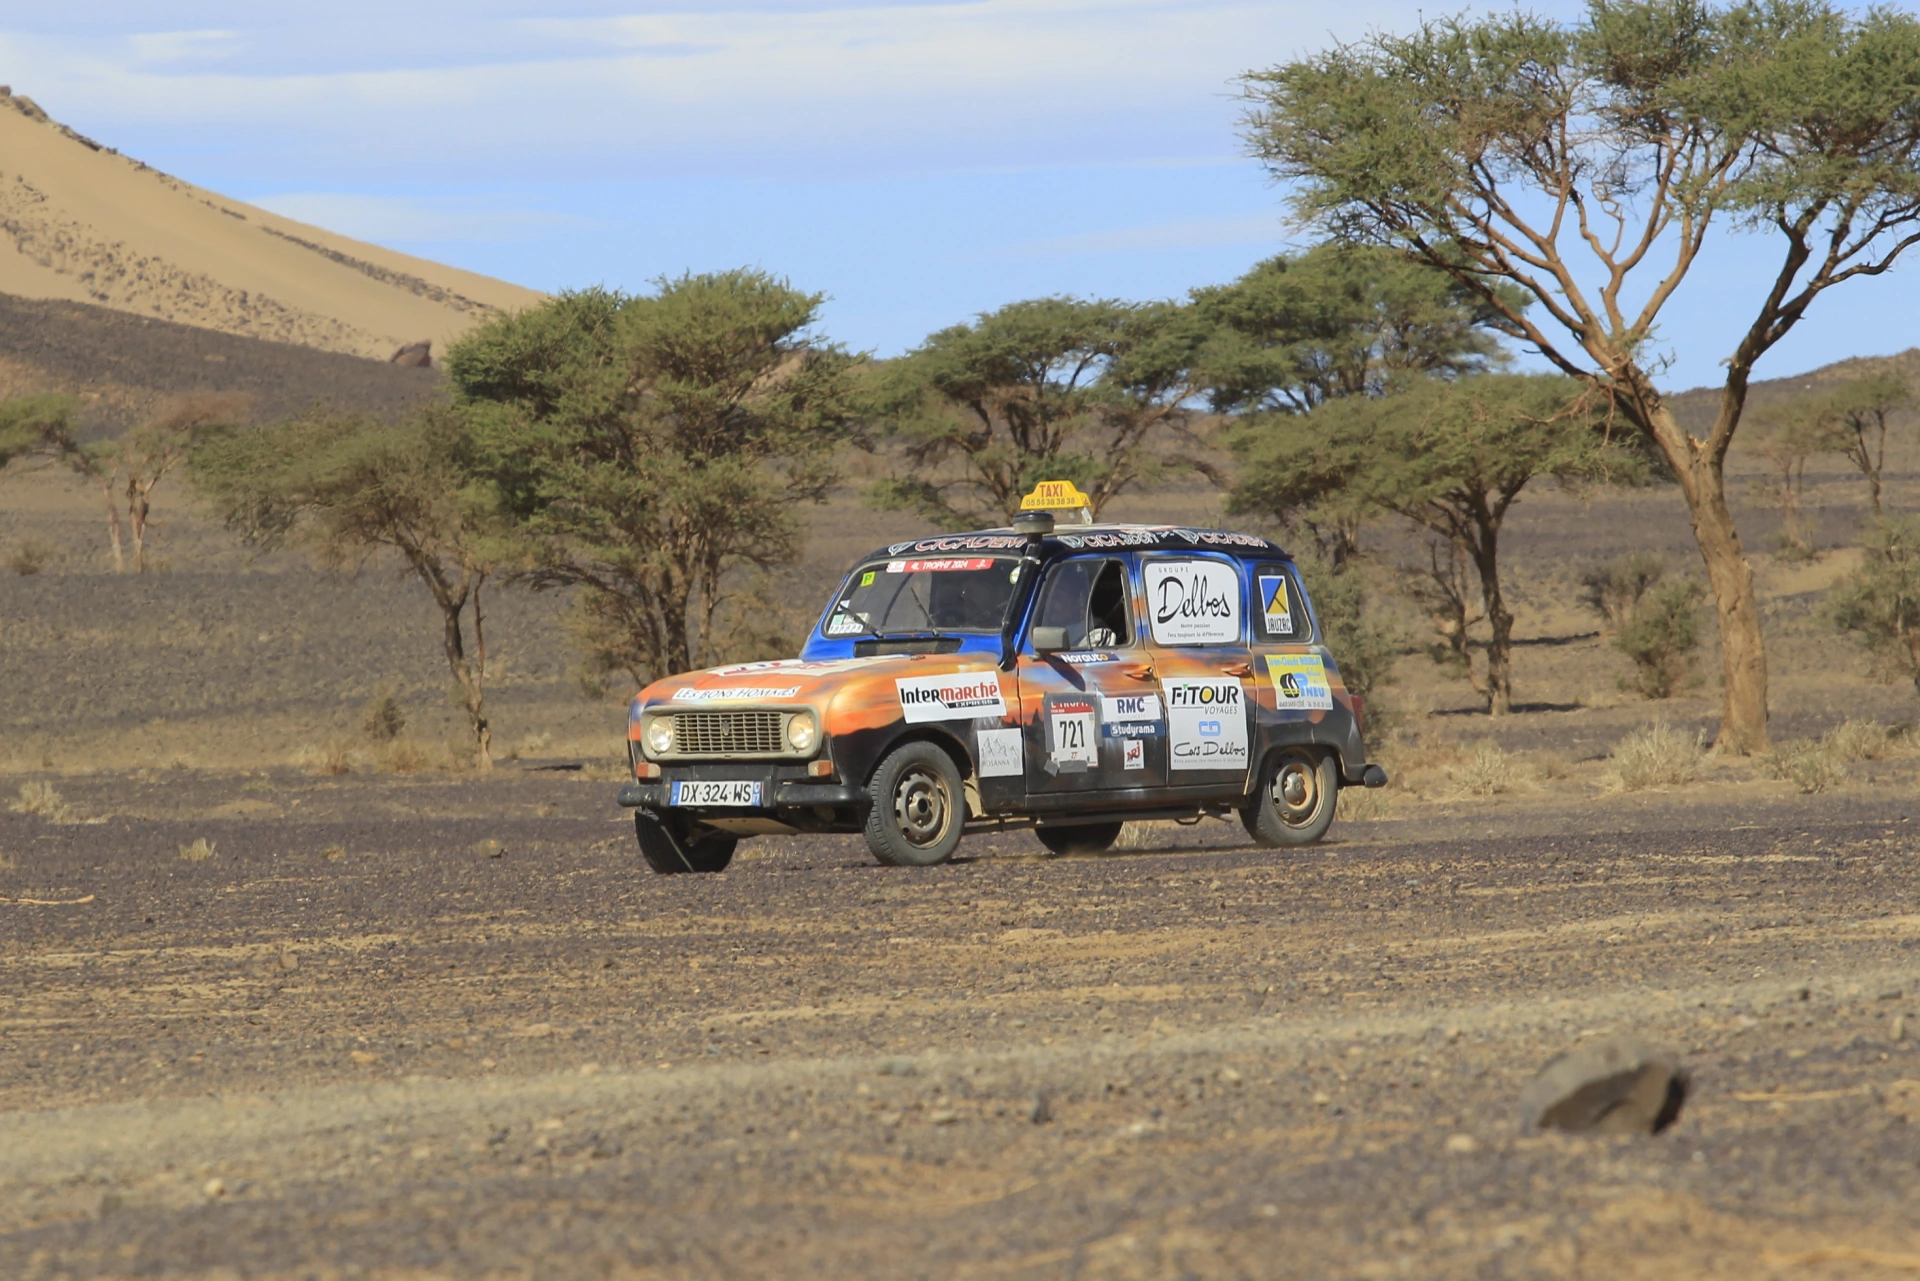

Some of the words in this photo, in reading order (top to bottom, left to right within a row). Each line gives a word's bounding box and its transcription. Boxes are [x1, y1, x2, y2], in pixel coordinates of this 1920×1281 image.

[1040, 484, 1063, 497] TAXI
[914, 536, 1028, 552] CICADEM
[922, 560, 950, 570] TROPHY
[951, 560, 969, 569] 2024
[1157, 573, 1231, 624] Delbos
[1267, 617, 1291, 632] JAUZAC
[1060, 653, 1108, 663] Norauto
[676, 688, 699, 698] LES
[699, 688, 736, 699] BONS
[1116, 697, 1145, 714] RMC
[1204, 706, 1238, 715] VOYAGES
[1059, 719, 1085, 749] 721
[1111, 723, 1155, 737] Studyrama
